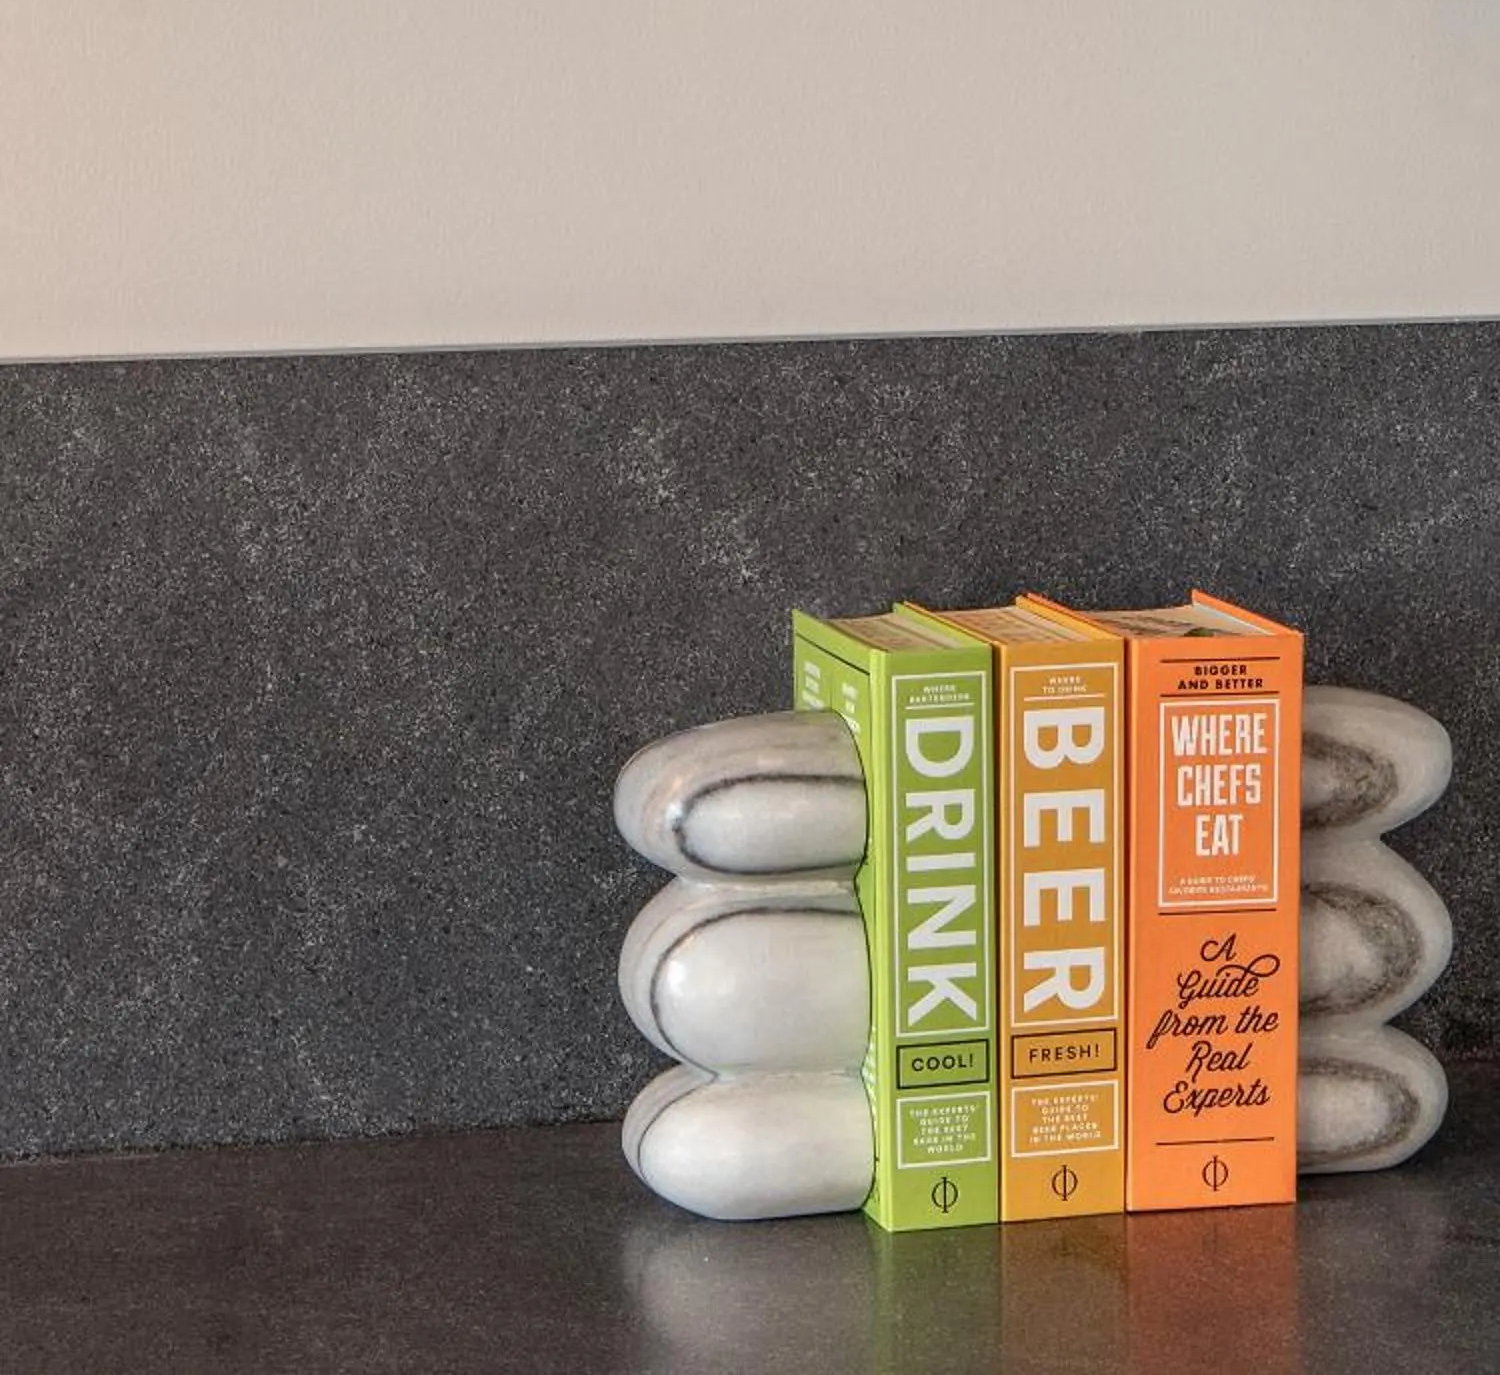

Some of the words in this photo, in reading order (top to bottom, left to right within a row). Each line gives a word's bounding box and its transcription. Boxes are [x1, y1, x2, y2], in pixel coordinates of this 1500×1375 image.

[1177, 679, 1209, 690] AND
[1215, 678, 1264, 690] BETTER
[1193, 664, 1248, 676] BIGGER
[1171, 713, 1268, 756] WHERE
[1177, 763, 1261, 806] CHEFS
[1195, 814, 1243, 856] EAT
[905, 715, 977, 1026] DRINK
[1023, 706, 1105, 1013] BEER
[1200, 933, 1237, 961] A
[1176, 953, 1281, 1010] Guide
[1146, 1009, 1229, 1049] from
[1234, 1005, 1279, 1034] the
[911, 1054, 974, 1072] COOL!
[1028, 1044, 1100, 1064] FRESH!
[1185, 1040, 1253, 1083] Real
[1163, 1078, 1271, 1118] Experts
